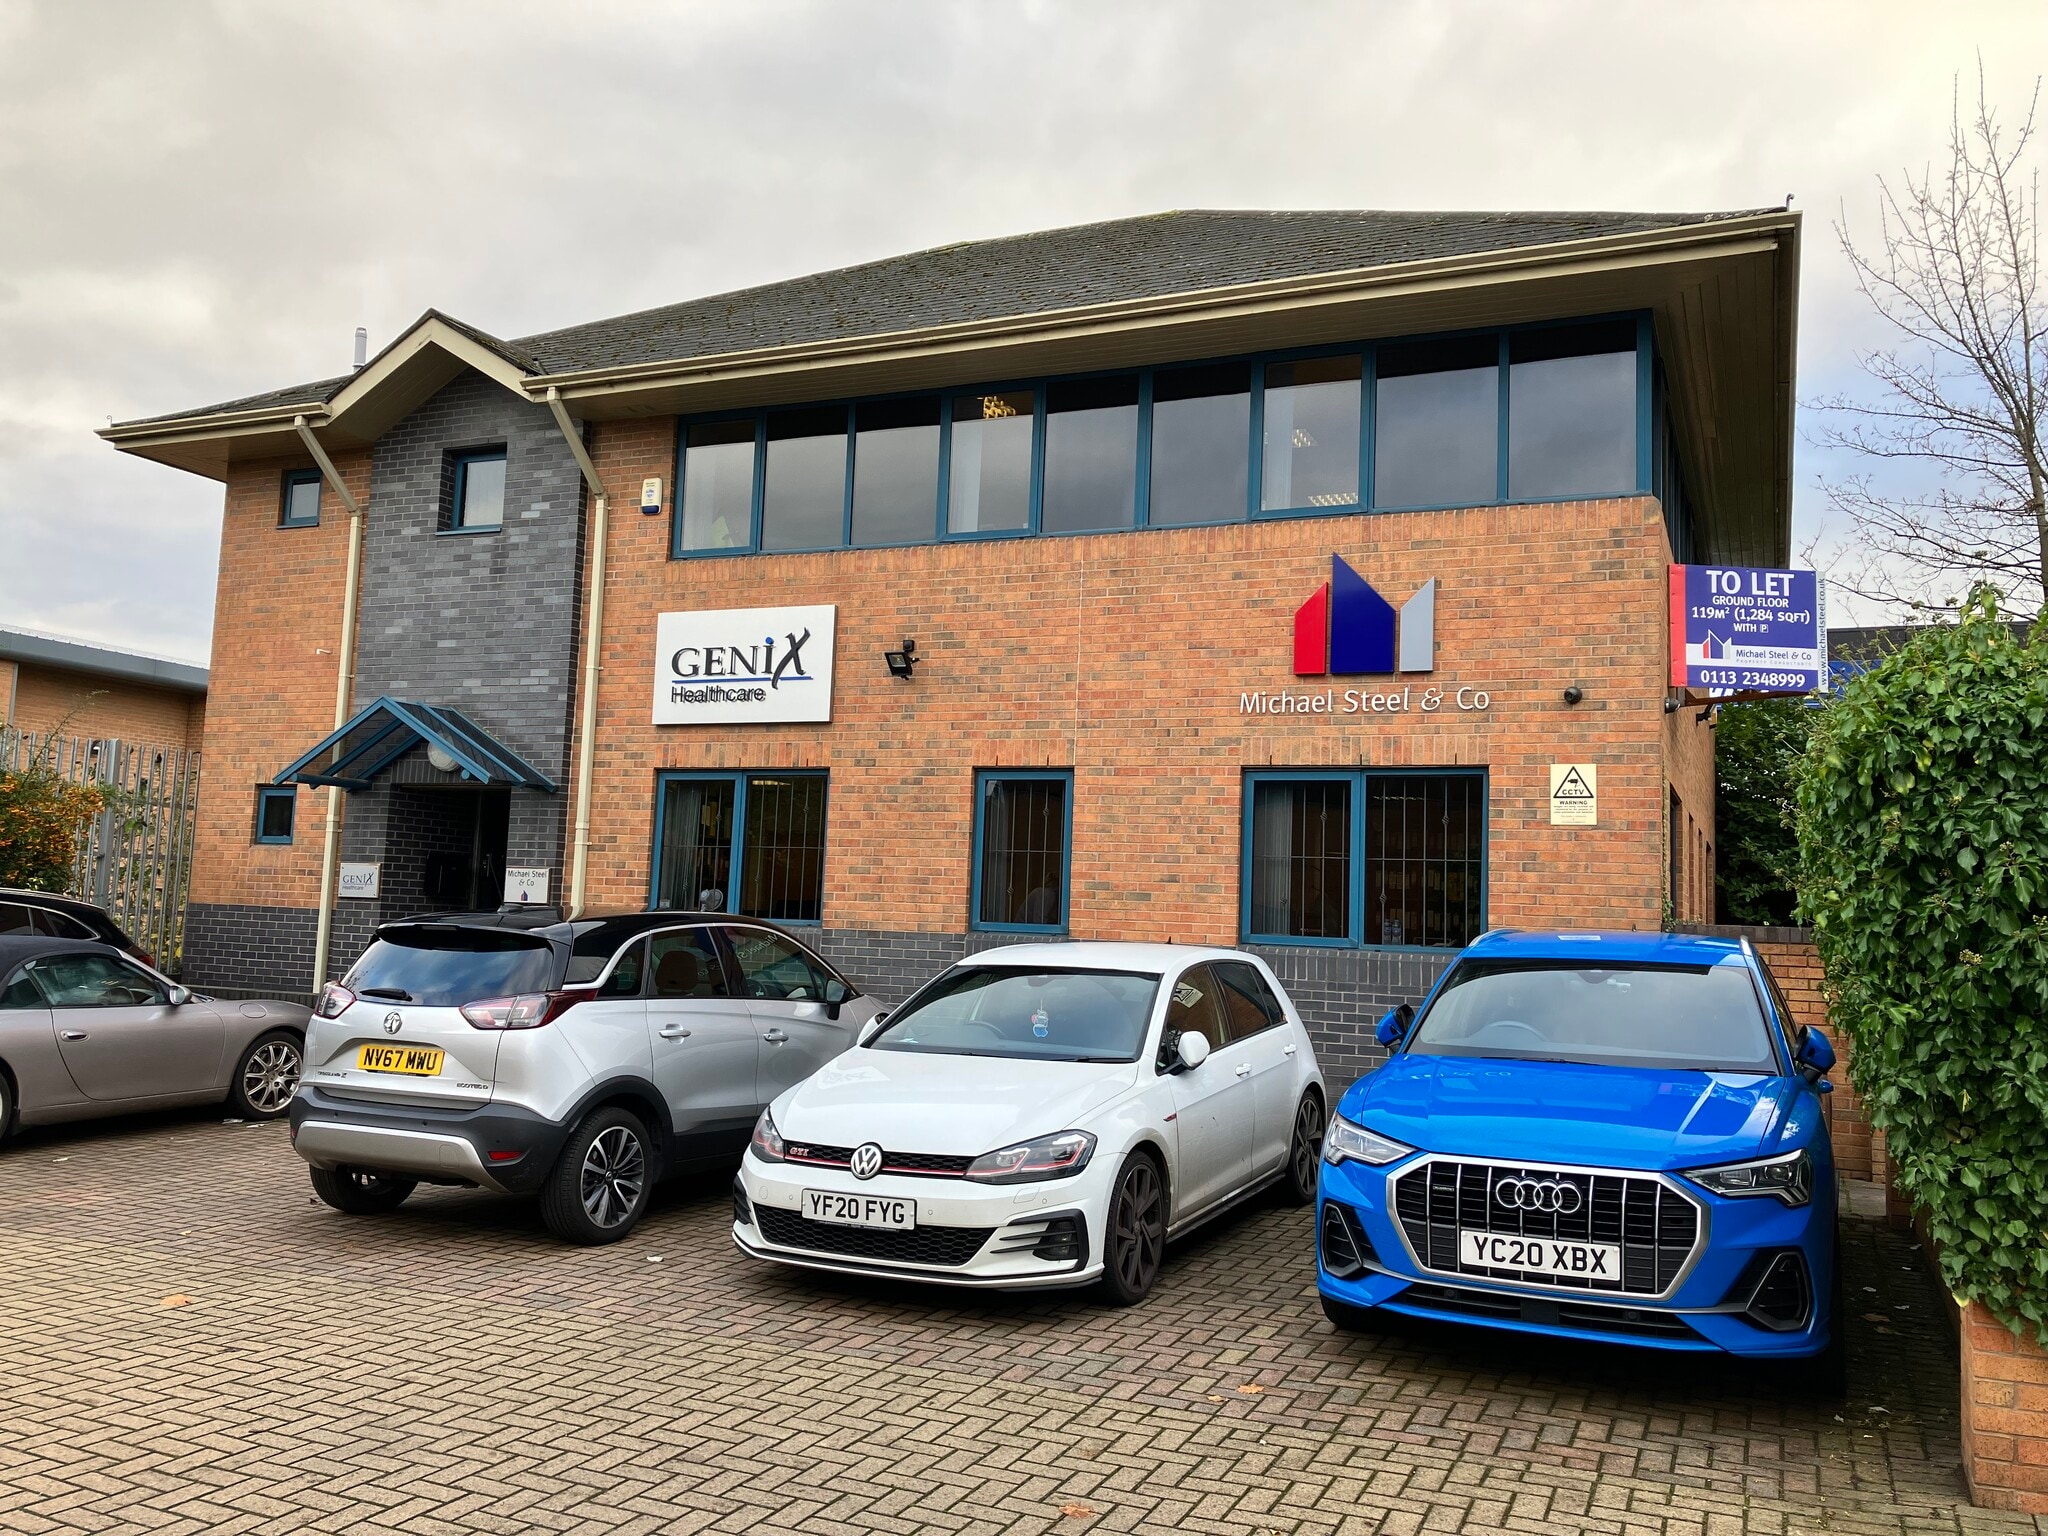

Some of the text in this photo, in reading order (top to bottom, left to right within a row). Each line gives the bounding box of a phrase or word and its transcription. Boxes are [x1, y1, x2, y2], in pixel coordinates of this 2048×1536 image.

[1705, 569, 1795, 597] TO LET
[1712, 595, 1789, 608] GROUND FLOOR
[1734, 606, 1774, 622] (1,284
[1733, 622, 1757, 633] WITH
[1817, 577, 1827, 686] www.michaelsteel.co.uk
[1736, 649, 1812, 660] Michael Steel & Co
[1700, 670, 1805, 688] 0113 2348999
[671, 685, 767, 704] Healthcare
[1239, 686, 1490, 714] Michael Steel & Co
[508, 870, 547, 878] Michael Steel
[526, 878, 535, 887] Co
[363, 1048, 438, 1071] NV67 MWU
[789, 1146, 810, 1157] GTI
[810, 1193, 905, 1224] YF20 FYG
[1473, 1235, 1607, 1274] YC20 XBX
